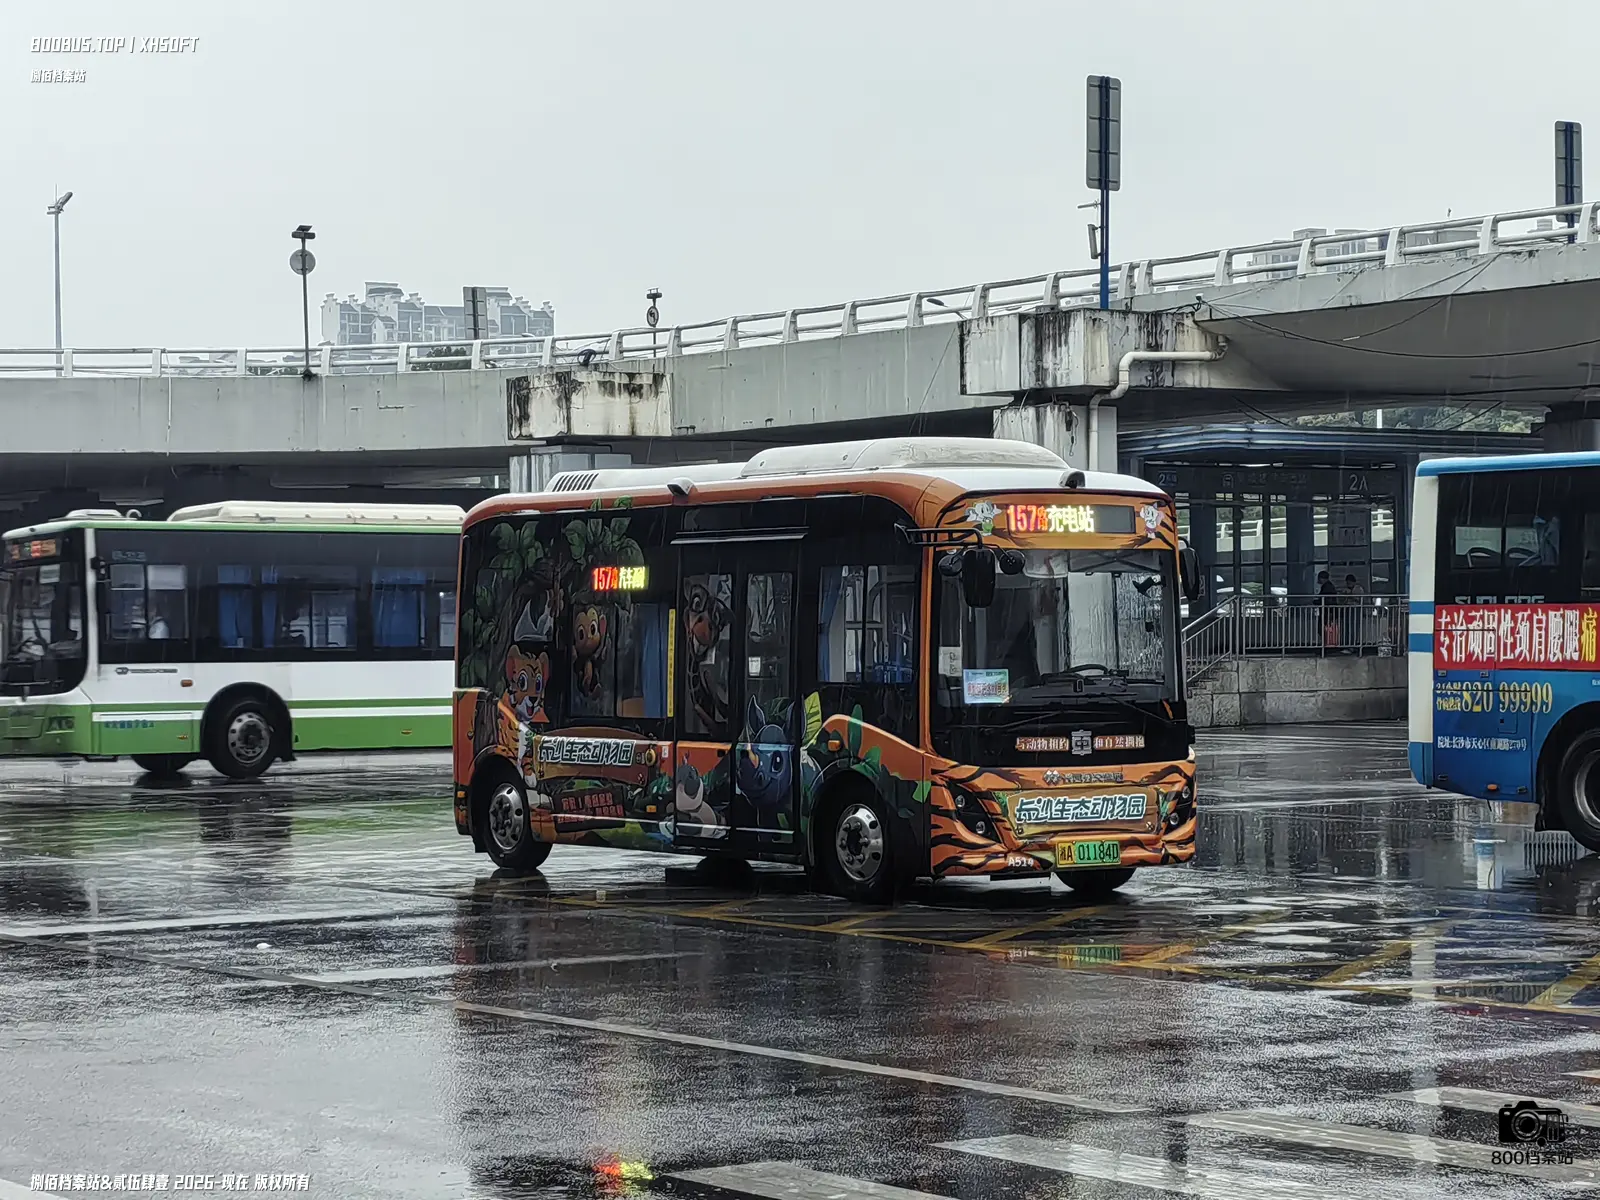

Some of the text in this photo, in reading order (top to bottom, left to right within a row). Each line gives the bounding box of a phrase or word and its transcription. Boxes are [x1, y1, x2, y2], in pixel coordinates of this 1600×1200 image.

[1438, 607, 1597, 662] 专治顽固性颈肩腰腿痛
[1462, 682, 1493, 712] 820
[1499, 682, 1553, 713] 99999
[539, 736, 636, 766] 长沙生态动物园
[1015, 793, 1147, 823] 长沙生态动物园
[1078, 842, 1119, 861] 01184D
